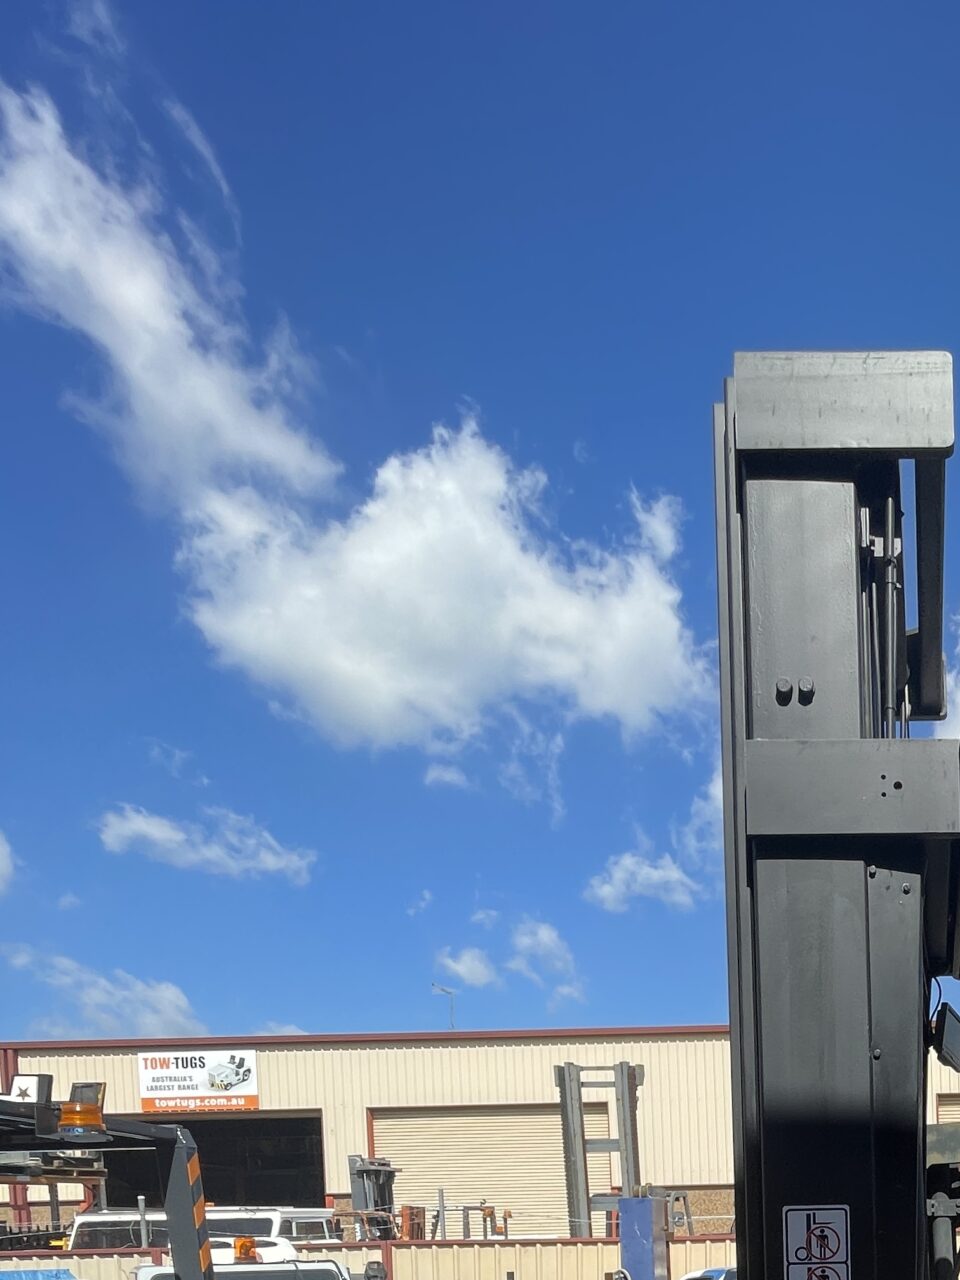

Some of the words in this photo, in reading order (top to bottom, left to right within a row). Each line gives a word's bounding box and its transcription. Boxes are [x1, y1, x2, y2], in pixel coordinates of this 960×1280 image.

[142, 1055, 206, 1070] TOW-TUGS
[151, 1075, 194, 1083] AUSTRALIA'S
[155, 1097, 245, 1108] towtugs.com.au
